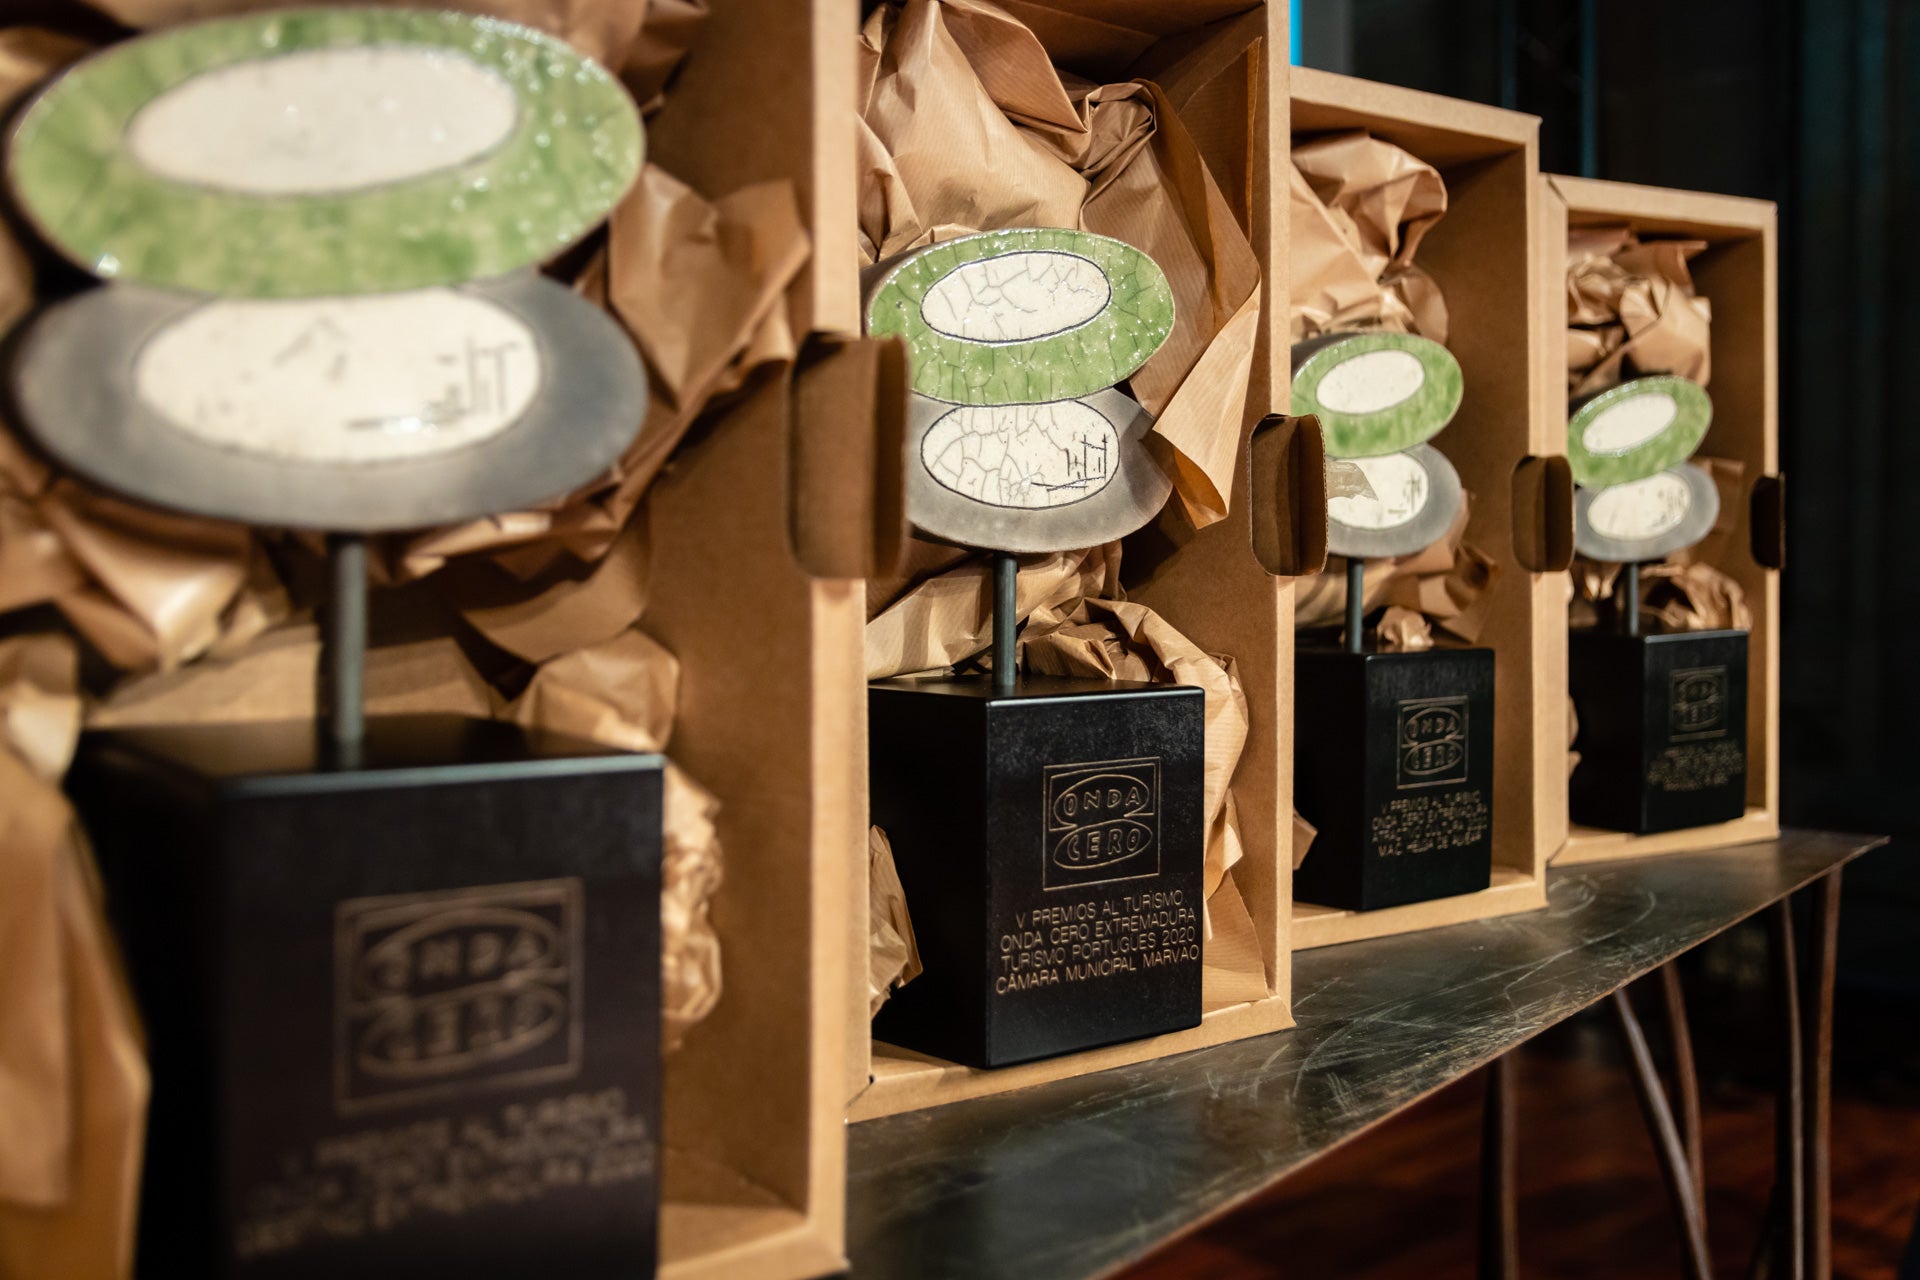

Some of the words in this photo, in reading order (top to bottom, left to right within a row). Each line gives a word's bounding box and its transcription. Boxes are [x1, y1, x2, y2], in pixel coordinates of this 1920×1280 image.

[1063, 786, 1141, 817] ONDA
[1067, 828, 1141, 861] CERO
[1015, 911, 1027, 929] V
[1032, 901, 1096, 927] PREMIOS
[1102, 900, 1120, 917] AL
[1123, 889, 1184, 914] TURISMO
[1000, 930, 1043, 953] ONDA
[1050, 922, 1089, 945] CERO
[1095, 907, 1196, 938] EXTREMADURA
[1000, 946, 1066, 974] TURISMO
[1161, 925, 1196, 947] 2020
[1065, 956, 1137, 983] MUNICIPAL
